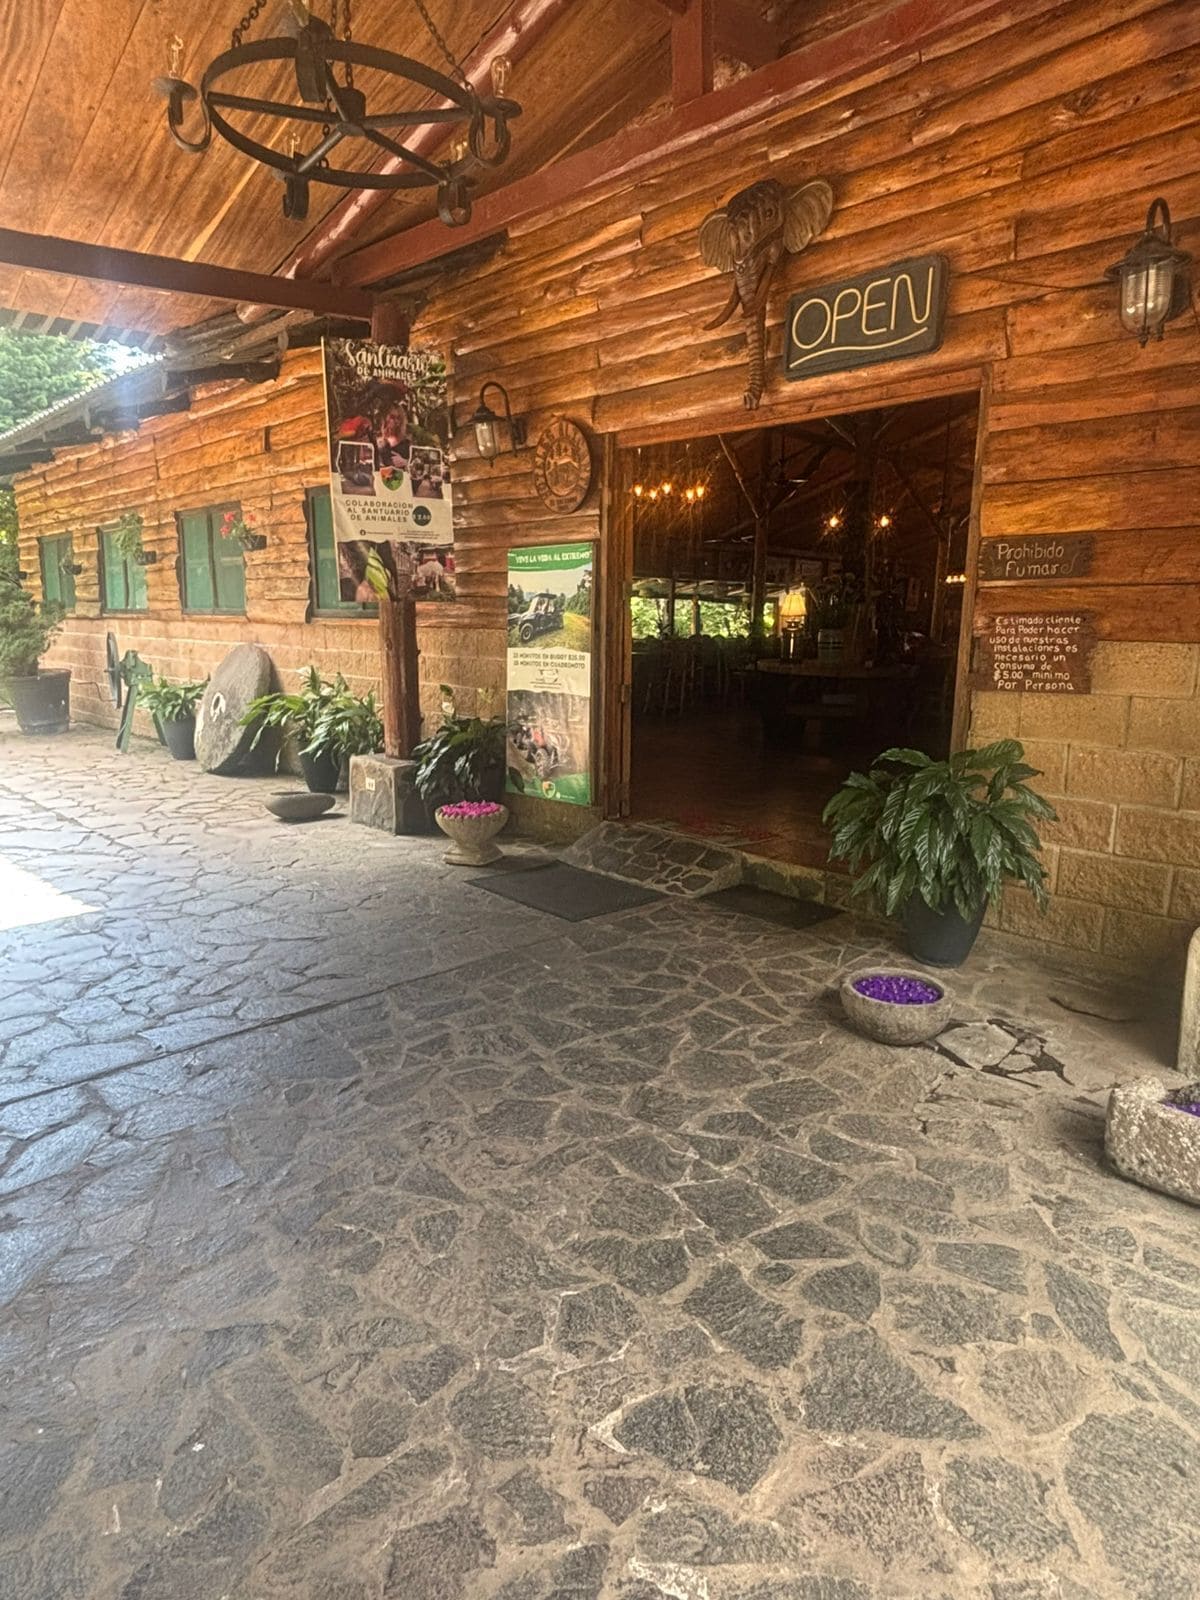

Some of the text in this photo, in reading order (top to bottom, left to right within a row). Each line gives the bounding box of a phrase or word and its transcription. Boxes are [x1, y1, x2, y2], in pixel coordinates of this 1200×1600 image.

[792, 266, 934, 349] OPEN
[361, 508, 410, 516] SANTUARIO
[365, 515, 408, 523] ANIMALES
[996, 541, 1065, 560] Prohibido
[1046, 615, 1081, 625] cliente
[995, 625, 1080, 634] Para Poder hacer
[989, 635, 1069, 645] uso de nuestras
[993, 644, 1078, 653] instalaciones es
[994, 653, 1066, 662] necesario un
[994, 661, 1053, 671] consumo de
[993, 670, 1070, 682] $5.00 minimo
[997, 680, 1075, 690] Por Persona
